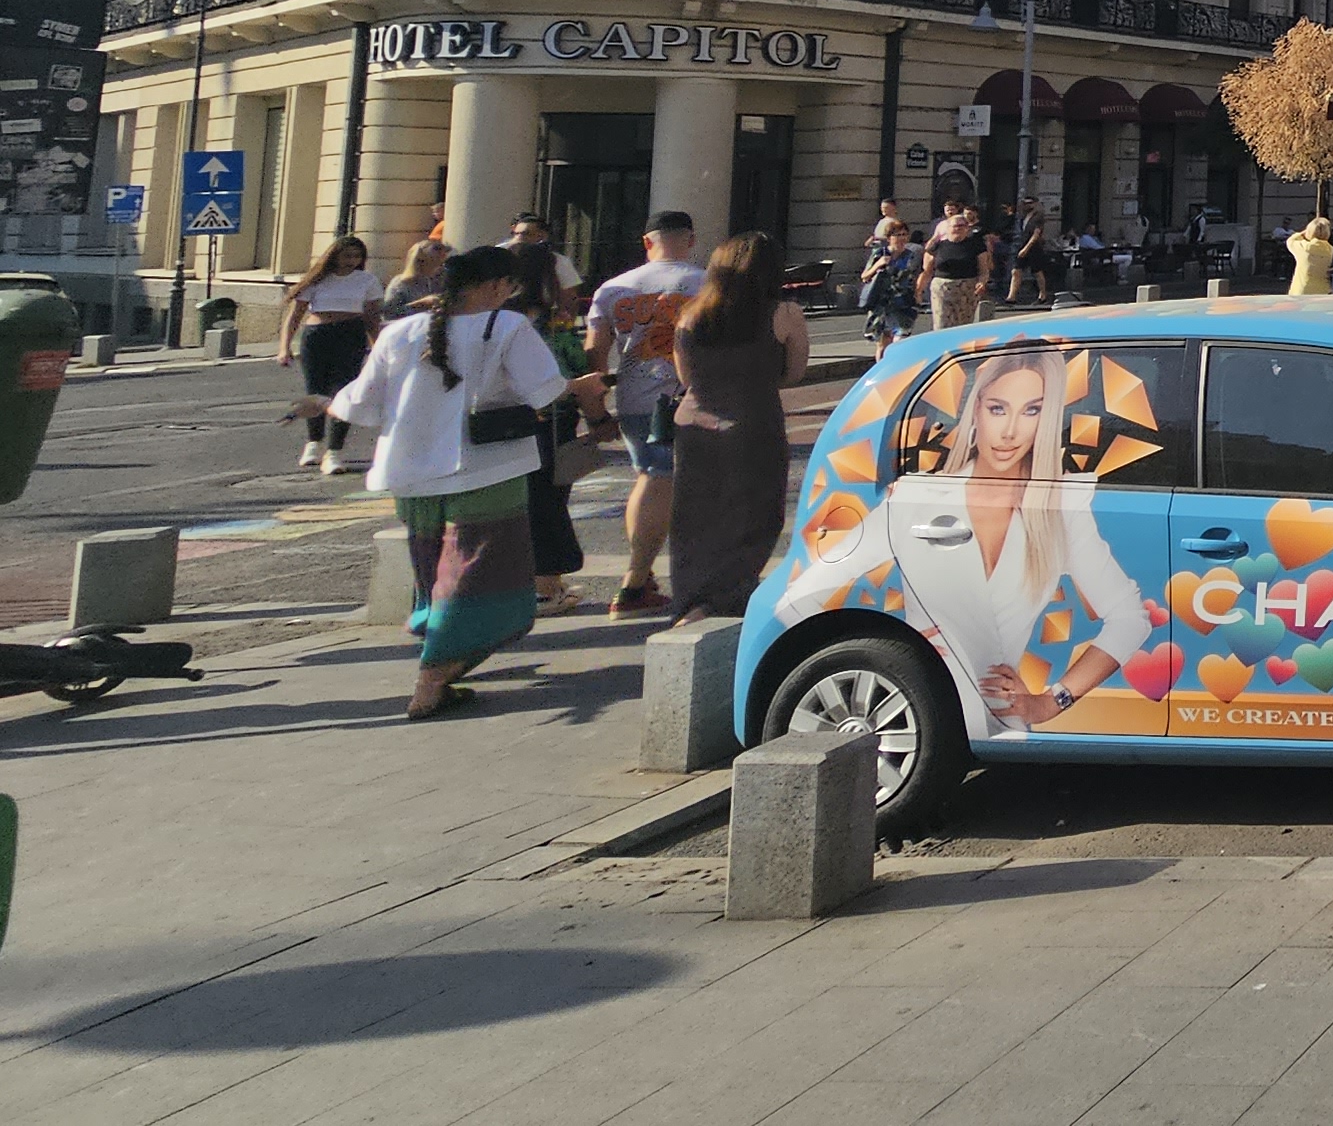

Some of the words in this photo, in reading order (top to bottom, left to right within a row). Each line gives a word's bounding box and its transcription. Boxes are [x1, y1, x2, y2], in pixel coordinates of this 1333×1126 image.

[368, 21, 518, 64] HOTEL
[544, 21, 841, 70] CAPITOL
[1177, 707, 1220, 723] WE
